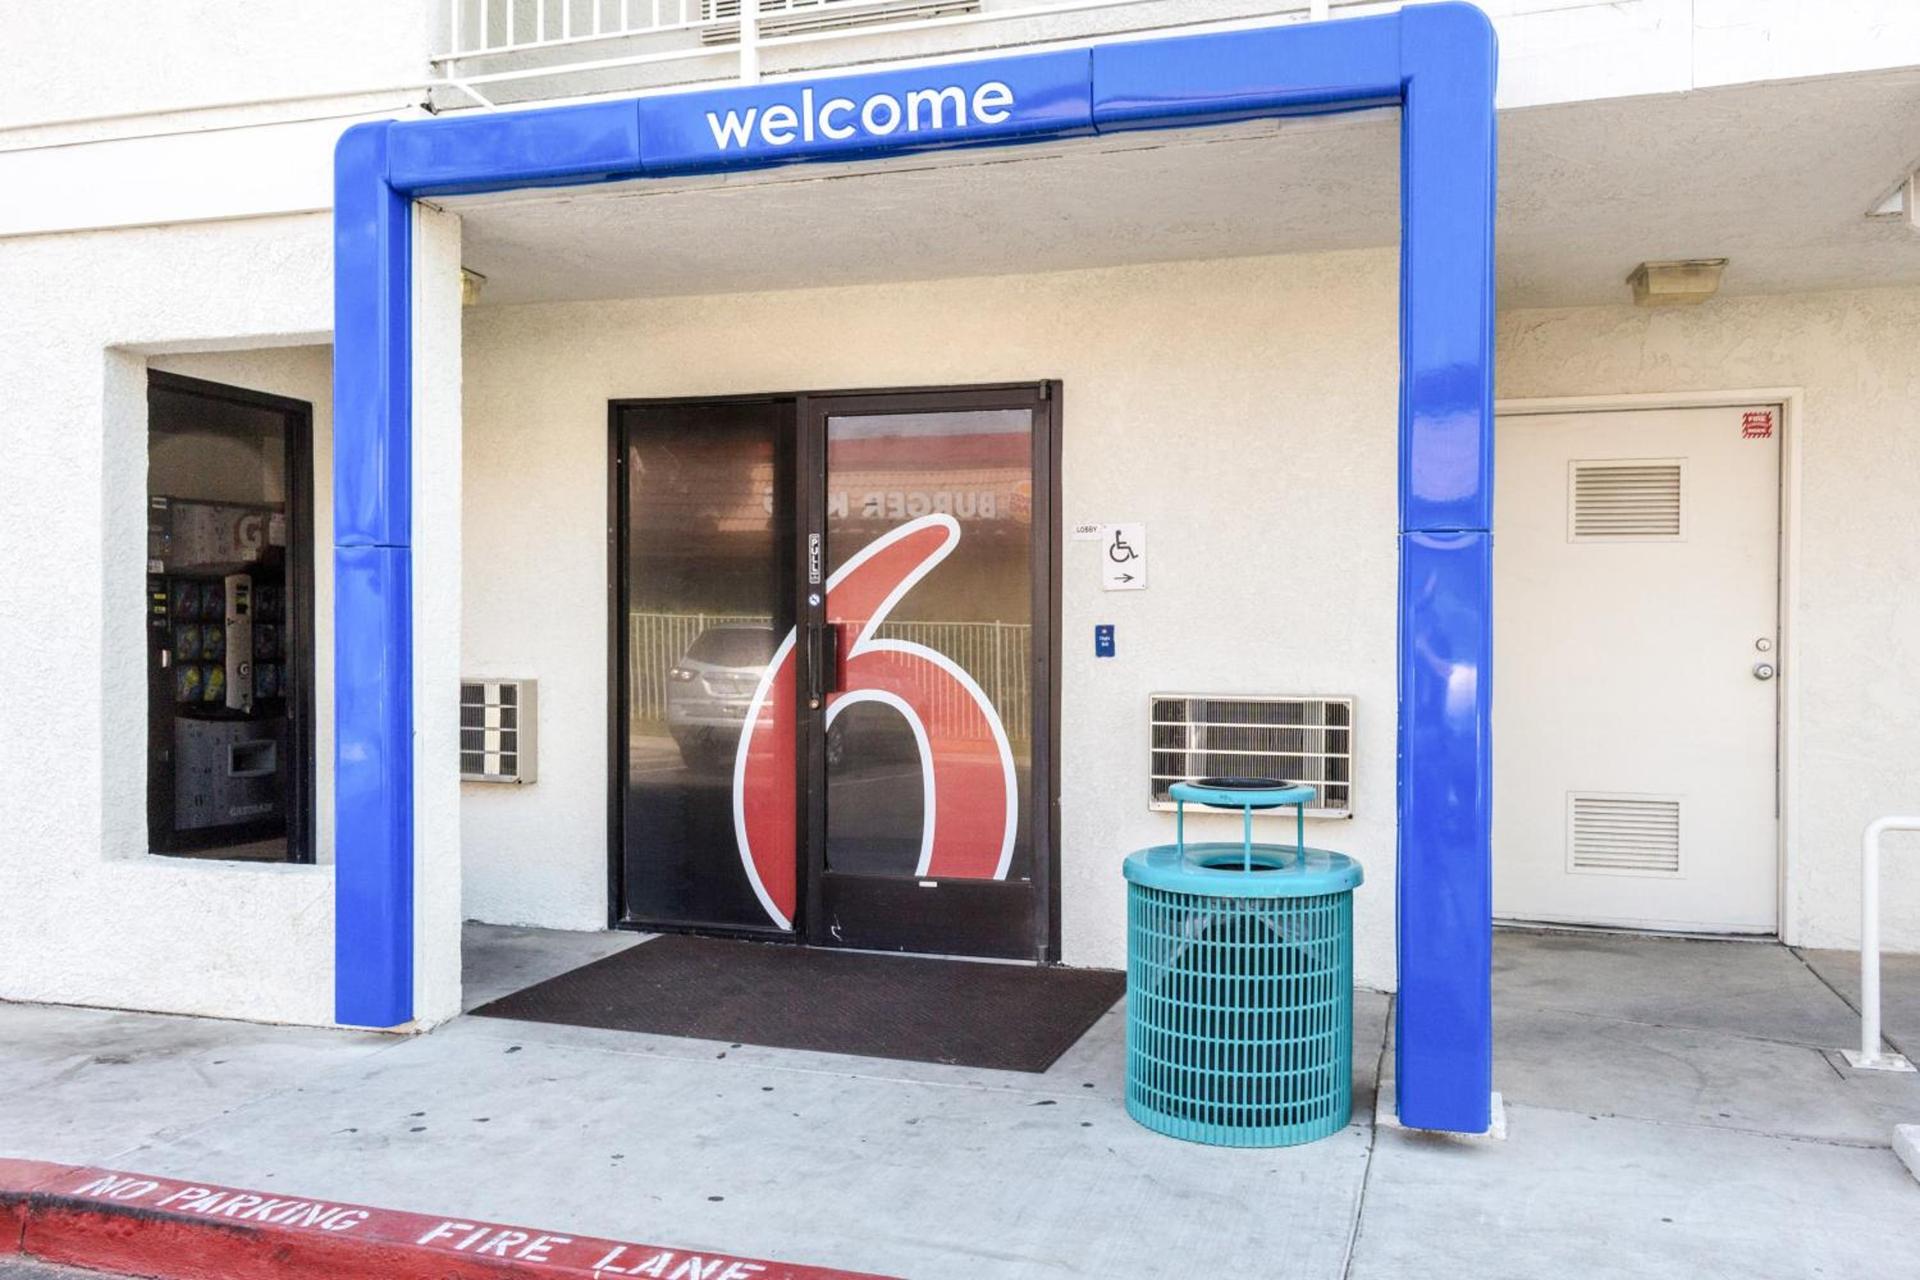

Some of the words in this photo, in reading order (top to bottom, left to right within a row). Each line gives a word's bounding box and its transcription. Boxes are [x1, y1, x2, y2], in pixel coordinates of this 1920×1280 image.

[706, 80, 1014, 150] welcome
[1076, 525, 1098, 534] LOBBY
[72, 1175, 160, 1199] NO
[155, 1187, 370, 1232] PARKING
[416, 1221, 573, 1262] FIRE
